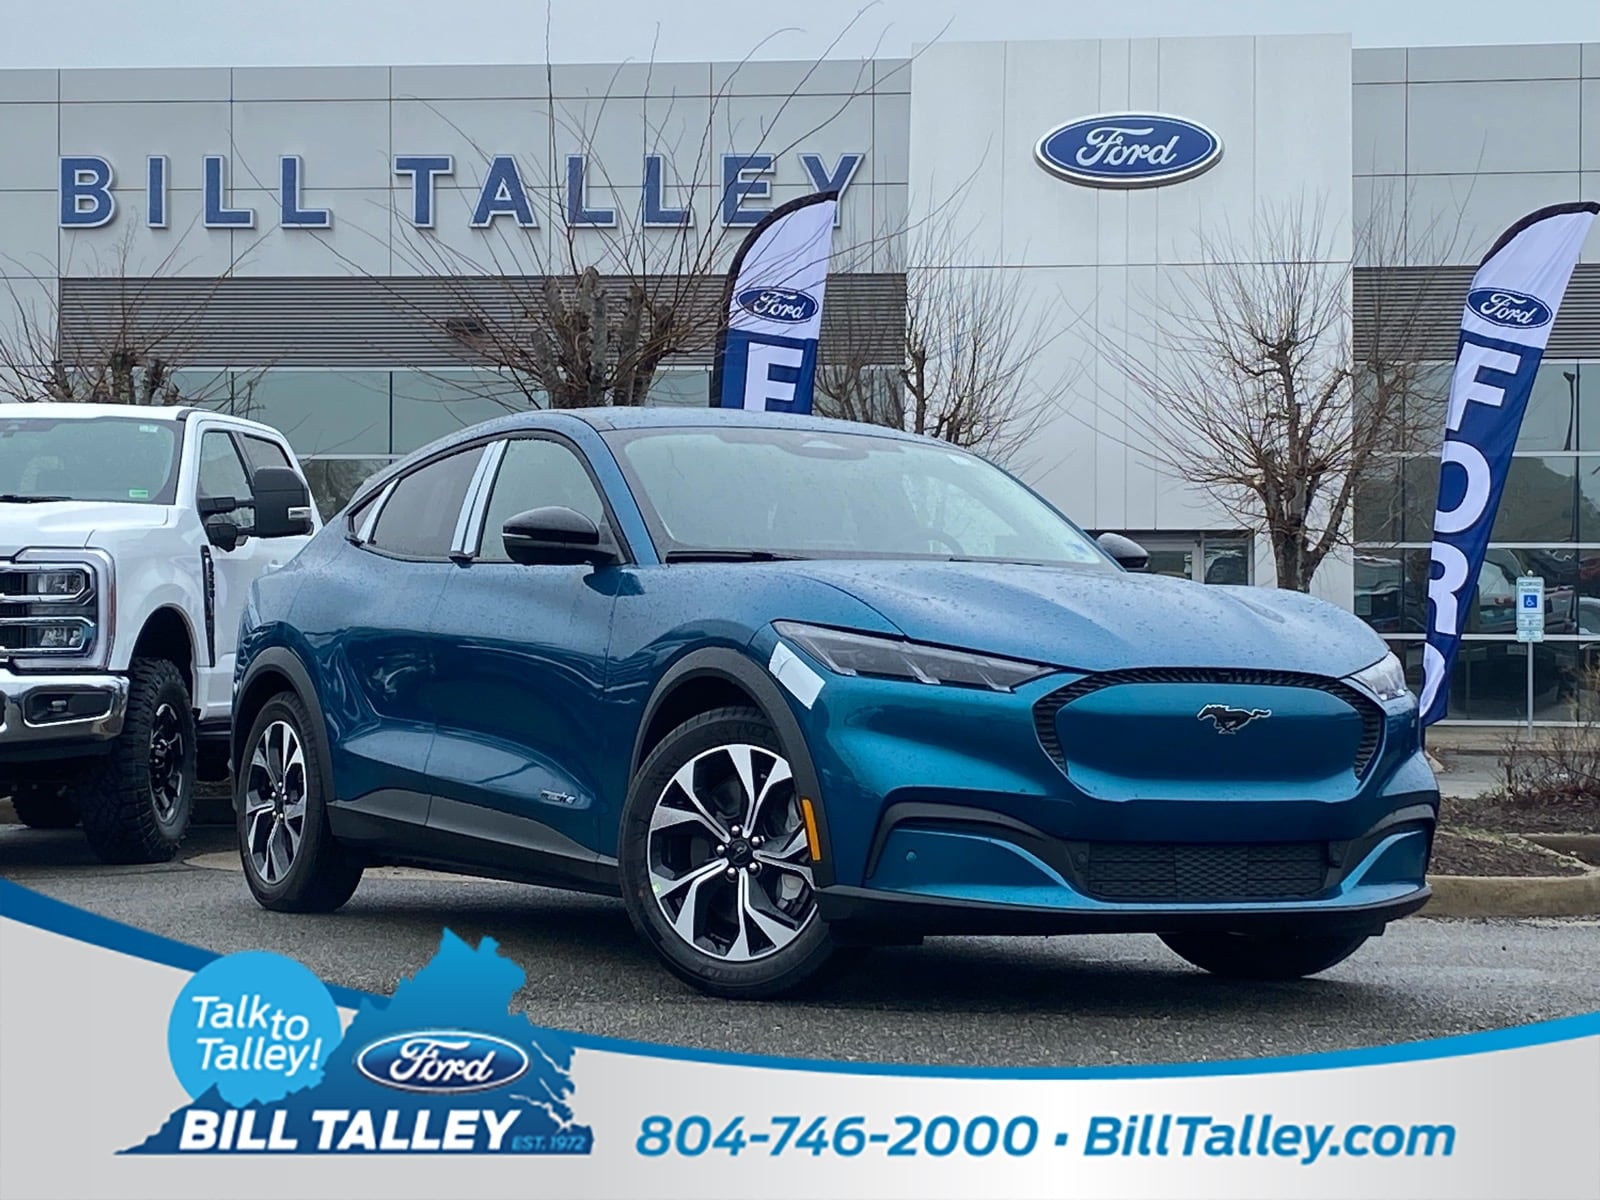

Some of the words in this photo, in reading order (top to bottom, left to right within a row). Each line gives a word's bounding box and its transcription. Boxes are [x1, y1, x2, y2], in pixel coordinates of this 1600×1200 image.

[1075, 127, 1181, 168] Ford
[58, 154, 332, 229] BILL
[393, 152, 866, 229] TALLEY
[752, 289, 805, 321] Ford
[1480, 292, 1536, 327] Ford
